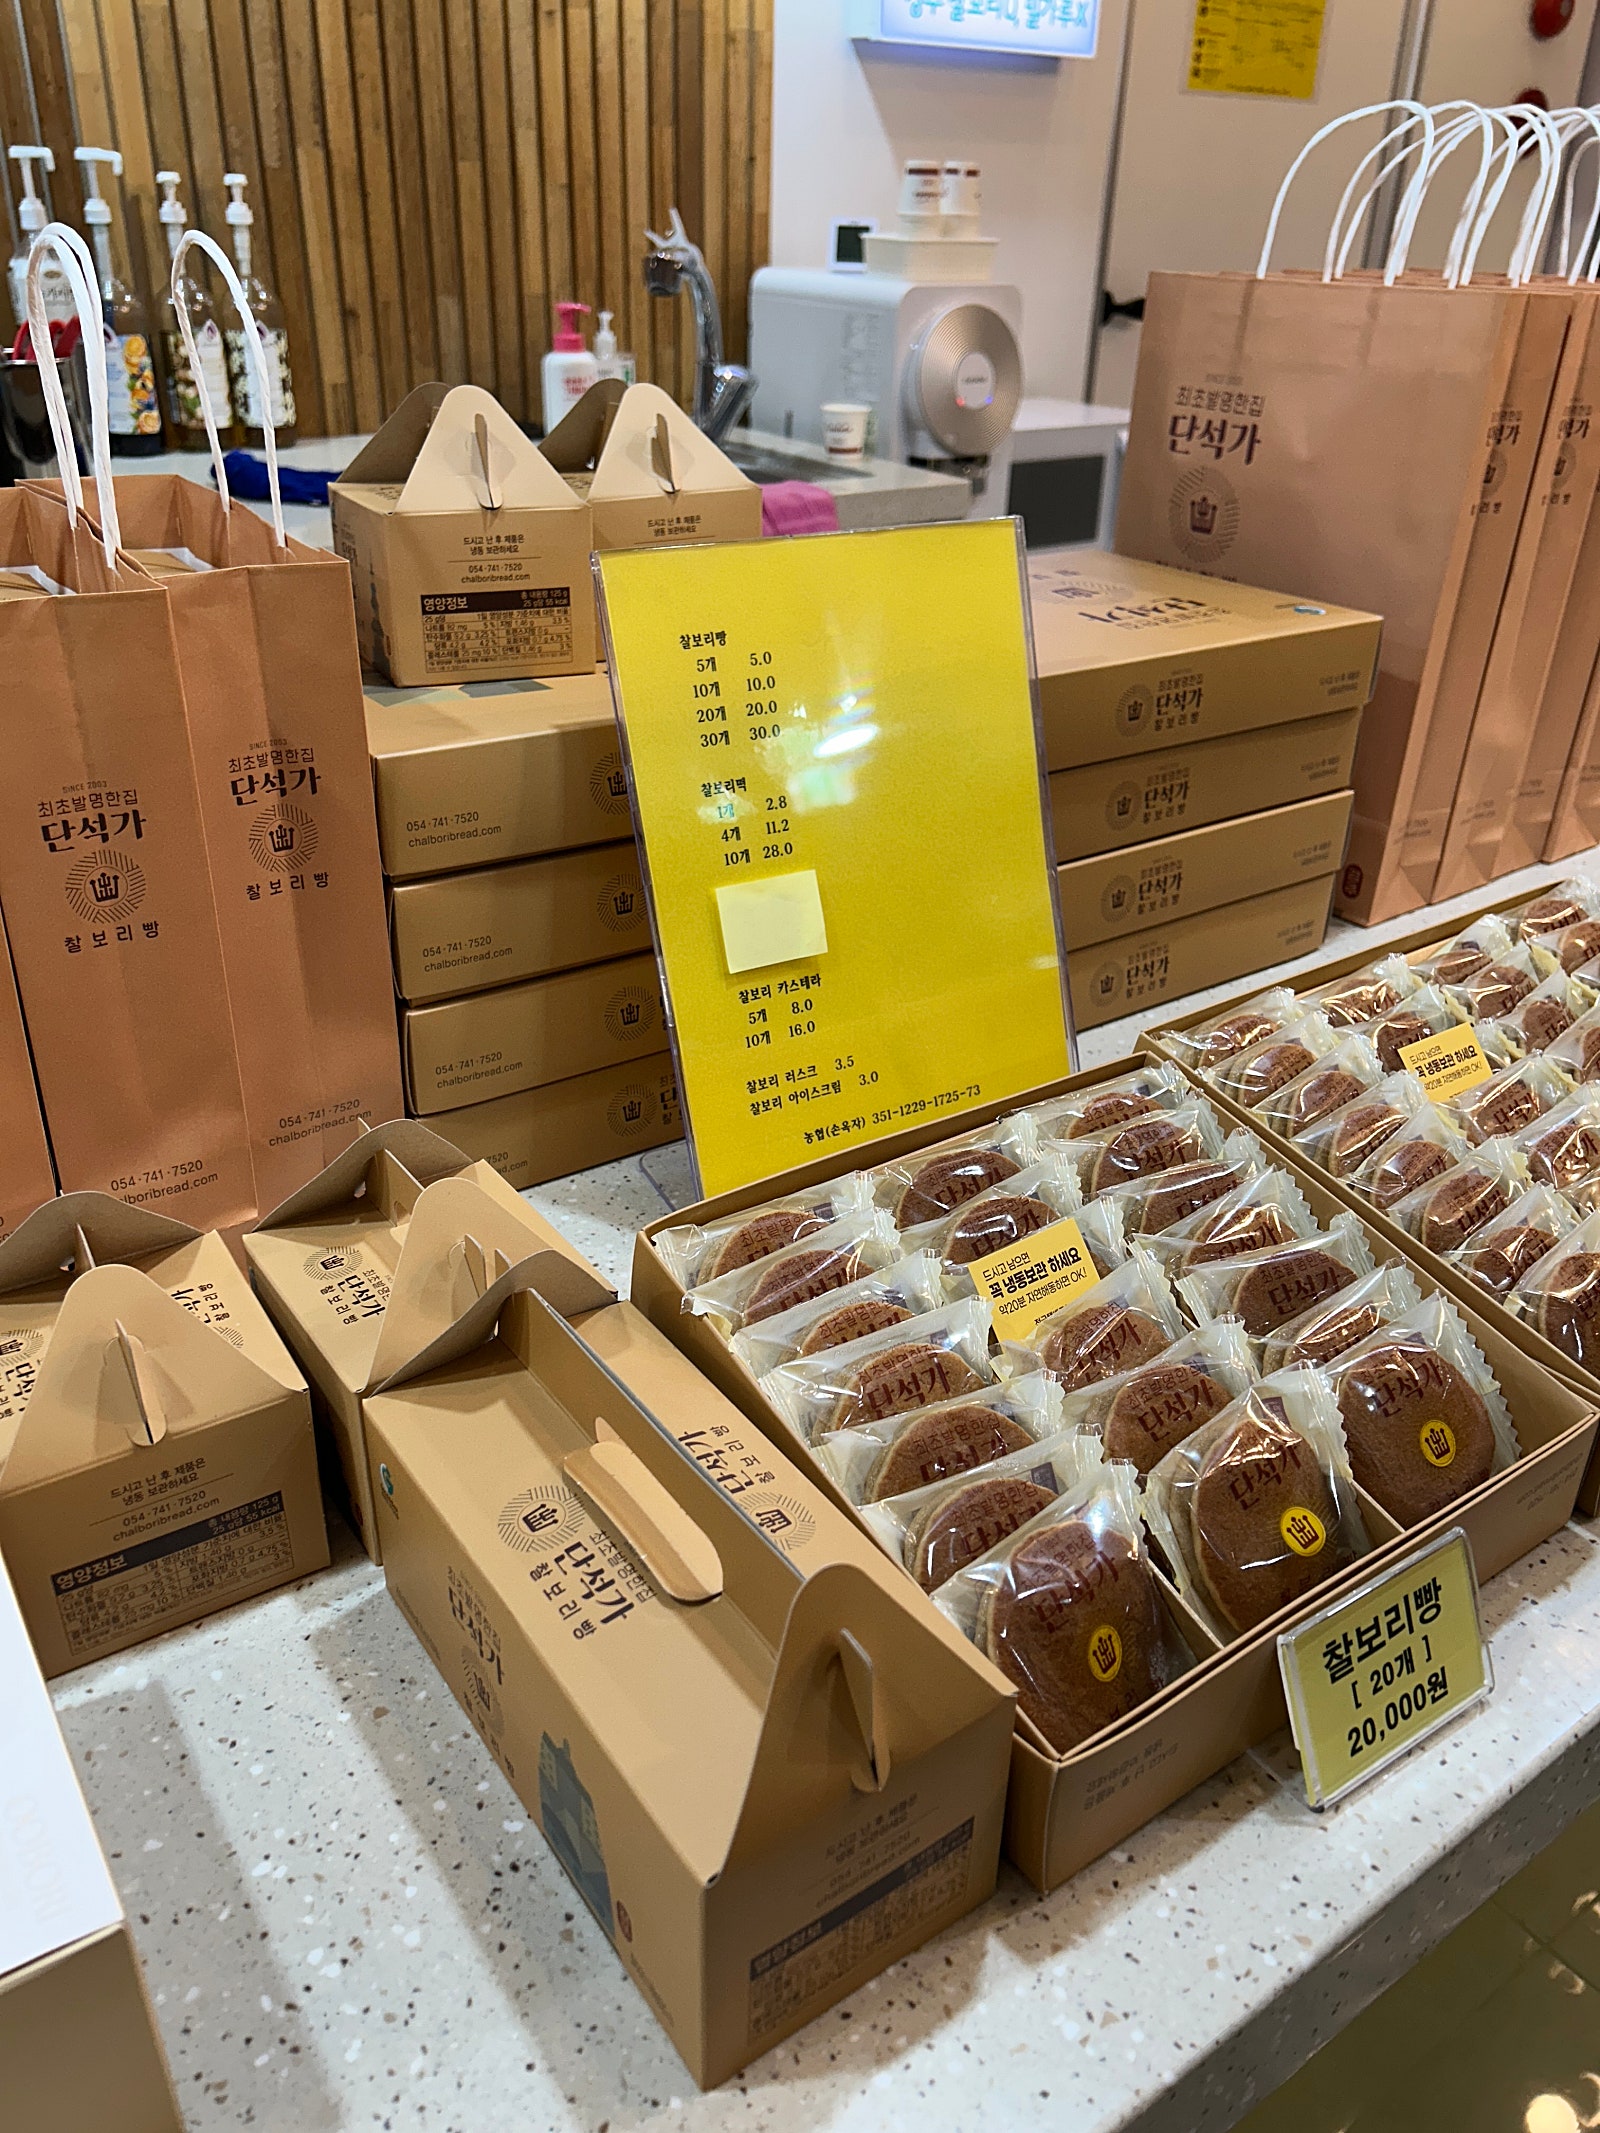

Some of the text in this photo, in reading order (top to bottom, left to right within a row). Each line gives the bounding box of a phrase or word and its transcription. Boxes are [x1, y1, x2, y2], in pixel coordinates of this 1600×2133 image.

[1168, 413, 1263, 466] 단석가
[463, 536, 484, 545] 드시고
[486, 535, 493, 545] 난
[423, 596, 469, 613] 영양정보
[679, 630, 727, 650] 찰보리빵
[696, 651, 772, 673] 5개 5.0
[692, 675, 776, 699] 10개 10.0
[1156, 687, 1204, 716] 단석가
[696, 700, 778, 724] 20개 20.0
[700, 724, 781, 748] 30개 30.0
[228, 747, 316, 774] 최초발명한집
[229, 766, 323, 806] 단석가
[701, 776, 747, 798] 찰보리떡
[1145, 780, 1190, 810] 단석가
[37, 788, 139, 819] 최초발명한집
[717, 796, 787, 820] 1개 2.8
[40, 807, 148, 853] 단석가
[408, 823, 502, 849] chalboribread.com
[721, 819, 790, 843] 4개 11.2
[724, 842, 793, 867] 10개 28.0
[245, 871, 331, 902] 찰보리빵
[1138, 871, 1182, 901] 단석가
[63, 920, 161, 955] 찰보리빵
[423, 945, 514, 974] chalboribread.com
[1126, 956, 1169, 986] 단석가
[738, 973, 822, 1005] 찰보리 카스테라
[748, 998, 813, 1025] 5개 8.0
[745, 1020, 816, 1049] 10개 16.0
[436, 1060, 524, 1090] chalboribread.com
[746, 1055, 855, 1095] 찰보리 러스크 3.5
[1409, 1051, 1426, 1065] 드시고
[1424, 1051, 1455, 1076] 냉동보관
[1454, 1044, 1478, 1064] 하세요
[750, 1071, 879, 1117] 찰보리 아이스크림 3.0
[871, 1084, 981, 1125] 351-1229-1725-73
[268, 1107, 373, 1147] chalboribread.com
[982, 1251, 1031, 1282] 드시고 남으면
[988, 1247, 1082, 1300] 꼭 냉동보관 하세요
[319, 1284, 358, 1325] 찰보리빵
[337, 1274, 386, 1319] 단석가
[998, 1296, 1027, 1316] 약20분
[1025, 1278, 1071, 1304] 자연해동하면
[1069, 1266, 1087, 1284] OK!
[857, 1345, 938, 1384] 최초발명한집
[866, 1356, 949, 1419] 단석가
[1374, 1357, 1444, 1417] 단석가
[1138, 1378, 1214, 1442] 단석가
[677, 1430, 755, 1496] 단석가
[708, 1424, 776, 1486] 찰보리빵
[110, 1457, 206, 1499] 드시고 난 후 제품은
[122, 1472, 200, 1506] 냉동 보관하세요
[1228, 1443, 1302, 1511] 단석가
[113, 1496, 220, 1542] chalboribread.com
[55, 1554, 128, 1589] 영양정보
[553, 1540, 636, 1626] 단석가
[588, 1529, 657, 1604] 최초발명한집
[528, 1561, 598, 1641] 찰보리빵
[1322, 1577, 1443, 1685] 찰보리빵
[1369, 1648, 1416, 1696] 20개
[1347, 1667, 1449, 1758] 20,000원
